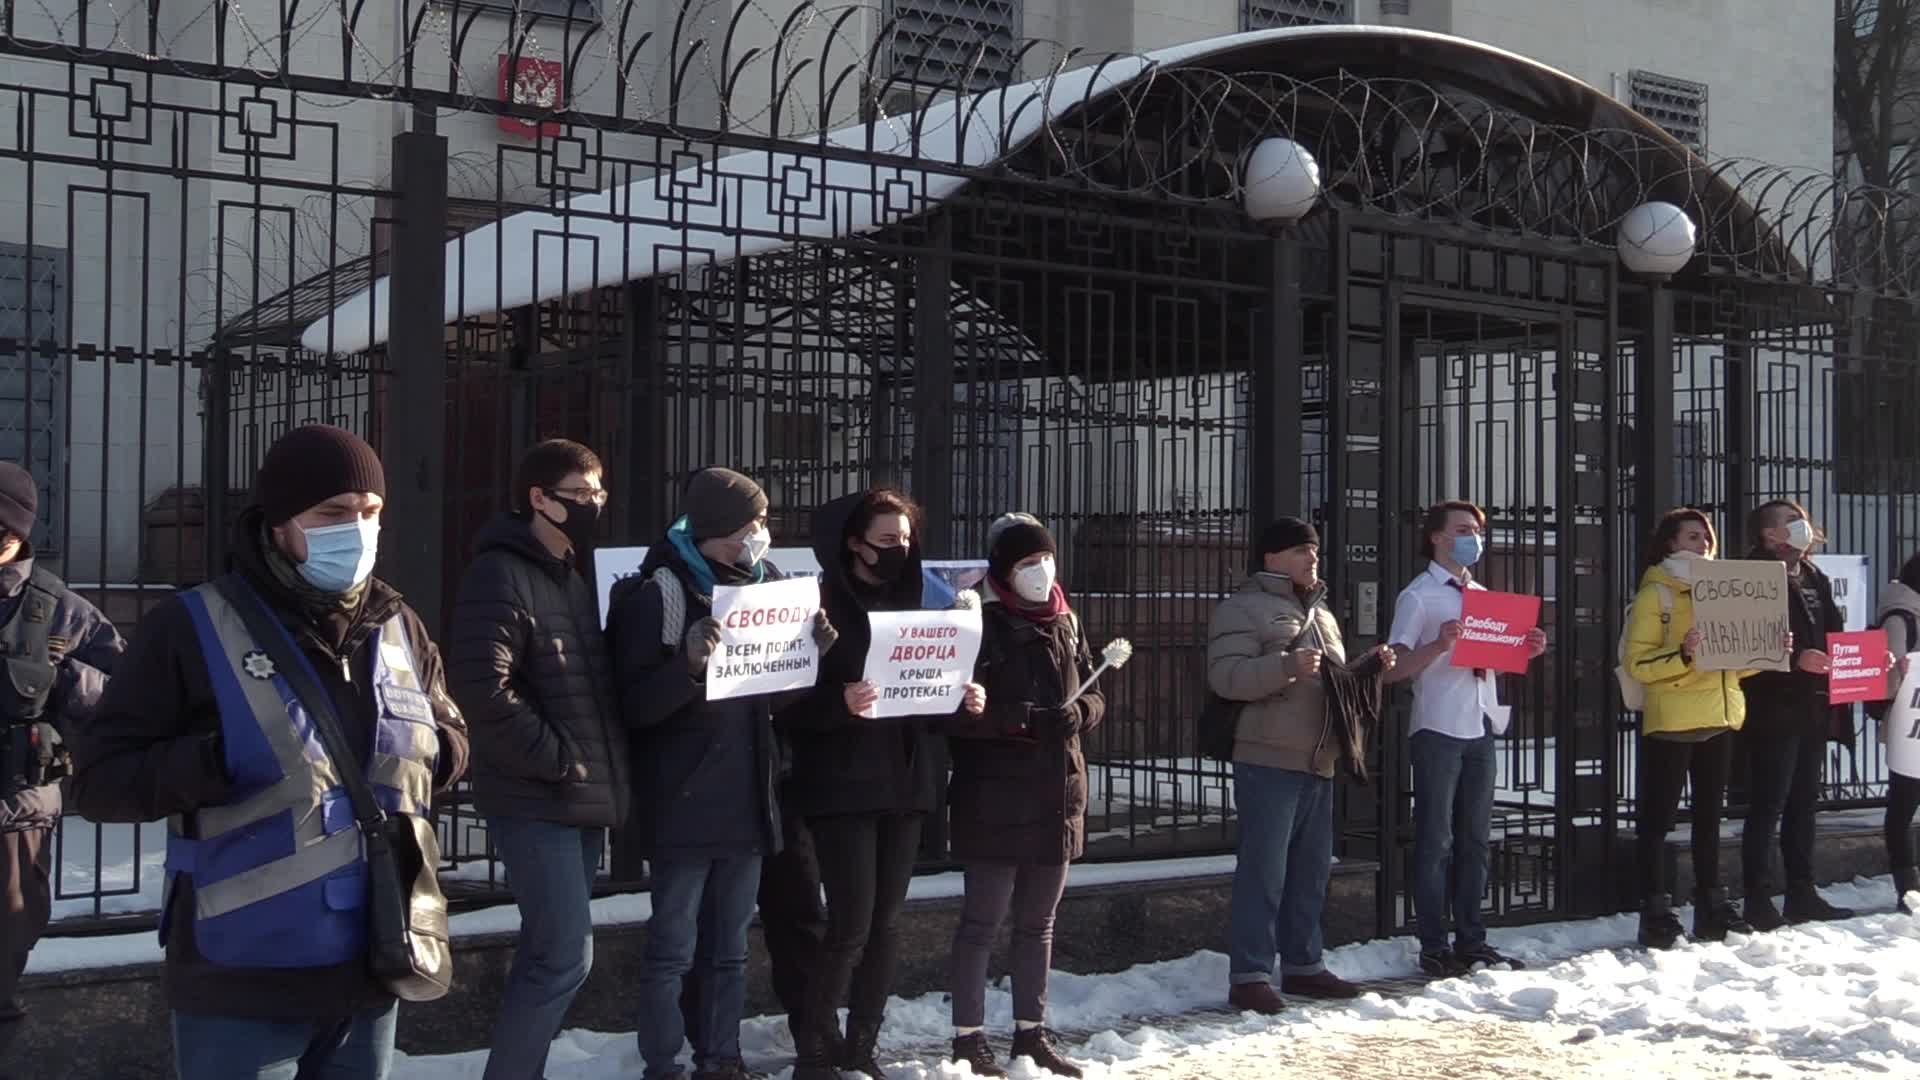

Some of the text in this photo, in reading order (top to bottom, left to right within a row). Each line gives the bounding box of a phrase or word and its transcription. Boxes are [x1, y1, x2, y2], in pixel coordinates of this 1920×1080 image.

[1694, 578, 1779, 602] СВОБОДУ
[726, 606, 811, 629] СВОБОДУ
[1464, 615, 1509, 634] Свободу
[900, 626, 958, 639] У ВАШЕГО
[1461, 628, 1528, 647] Навальному!
[726, 639, 806, 657] ВСЕМ ПОЛИТ-
[889, 644, 957, 663] ДВОРЦА
[1832, 642, 1860, 657] Путин
[715, 656, 811, 679] ЗАКЛЮЧЕННЫМ
[899, 667, 943, 681] КРЫША
[1832, 666, 1881, 681] Навального
[883, 684, 952, 700] ПРОТЕКАЕТ
